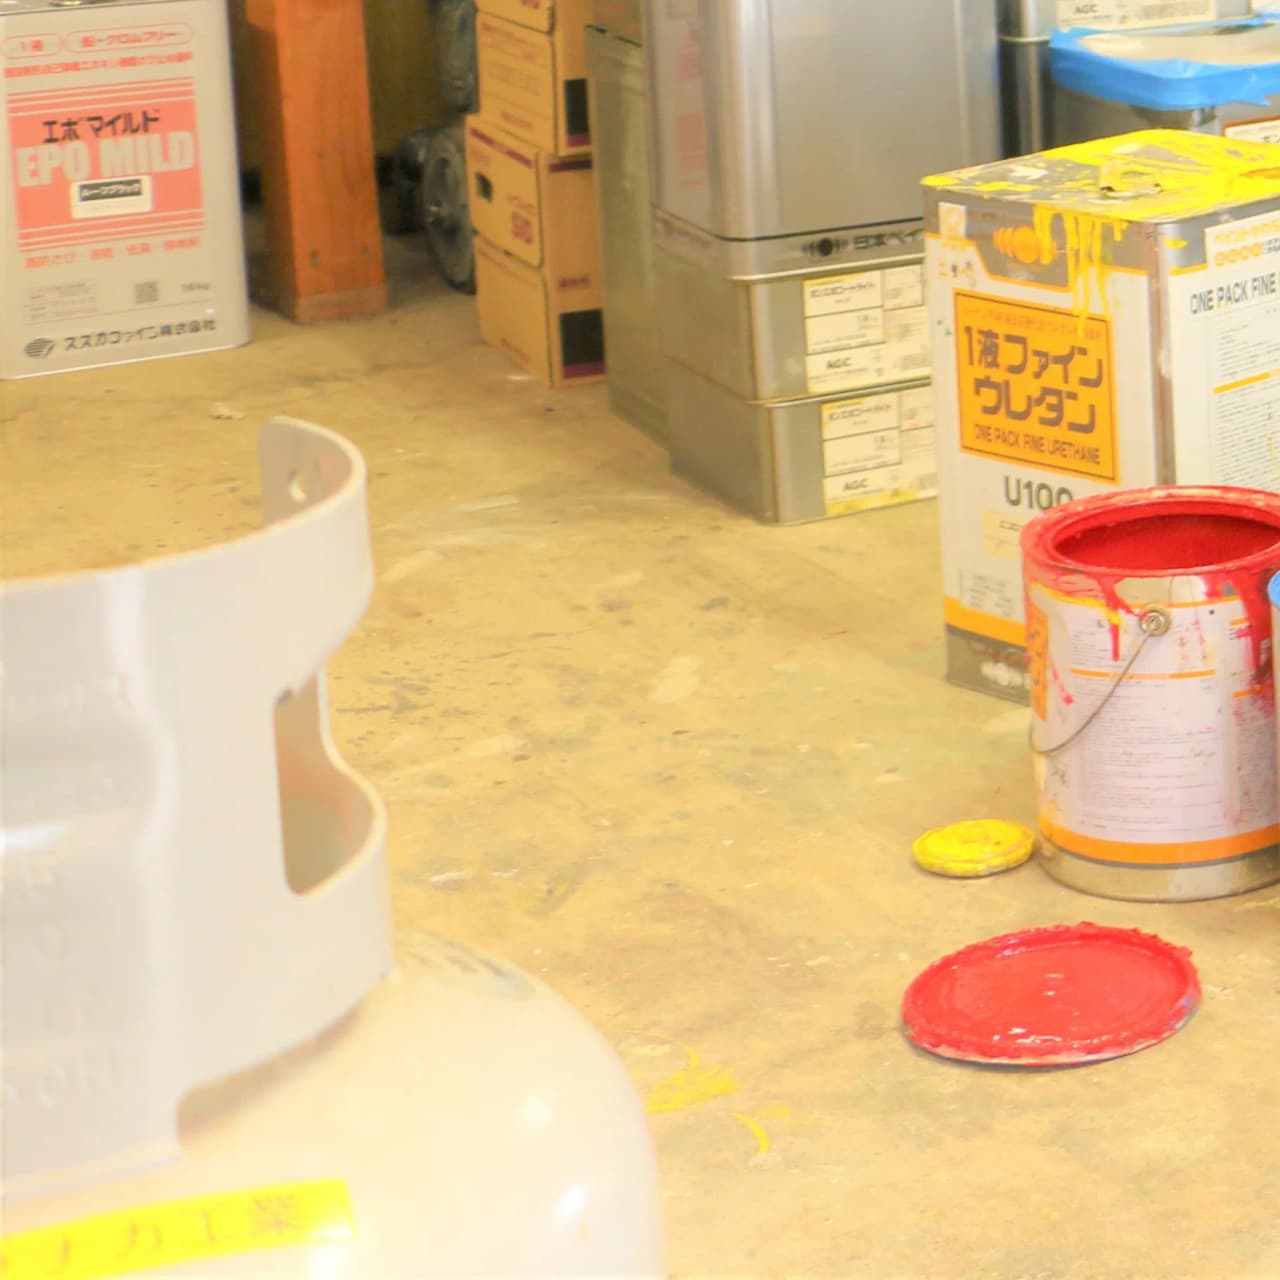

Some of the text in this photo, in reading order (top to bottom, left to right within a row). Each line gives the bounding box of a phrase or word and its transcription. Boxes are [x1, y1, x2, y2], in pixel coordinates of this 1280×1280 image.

[1073, 3, 1099, 15] AGC
[15, 130, 196, 188] EPO MILD
[1189, 289, 1214, 315] ONE
[1216, 281, 1249, 308] PACK
[1251, 276, 1276, 299] FINE
[826, 357, 852, 370] AGC
[964, 324, 1104, 390] 1液ファイン
[973, 375, 1097, 435] ウレタン
[973, 423, 1101, 466] ONE PACK FINE URETHANE
[842, 478, 869, 492] AGC
[1003, 475, 1076, 511] U100
